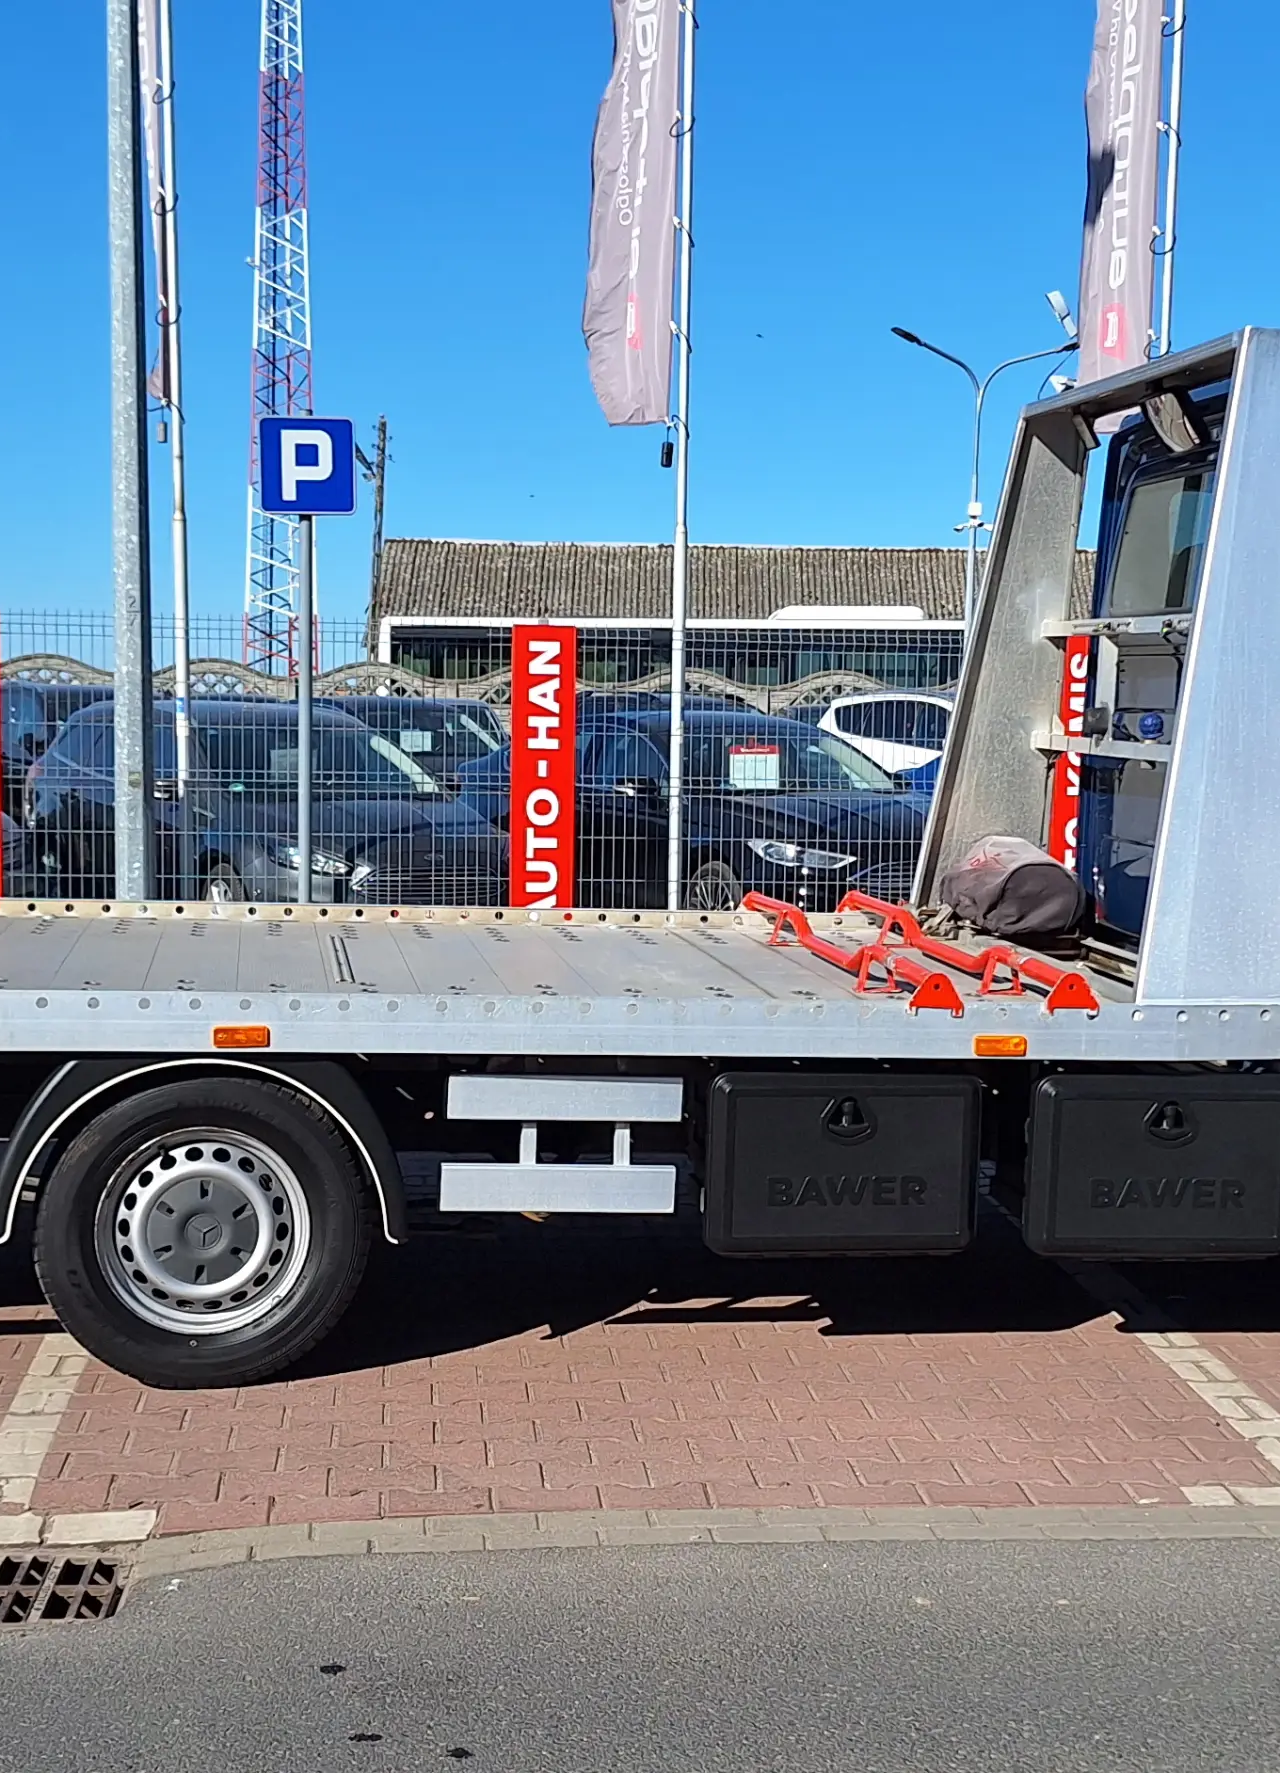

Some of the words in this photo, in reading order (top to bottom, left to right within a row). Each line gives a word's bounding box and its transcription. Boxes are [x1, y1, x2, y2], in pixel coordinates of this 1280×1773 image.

[280, 429, 333, 502] P
[766, 1176, 928, 1208] BAWER
[1089, 1177, 1246, 1209] BAWER
